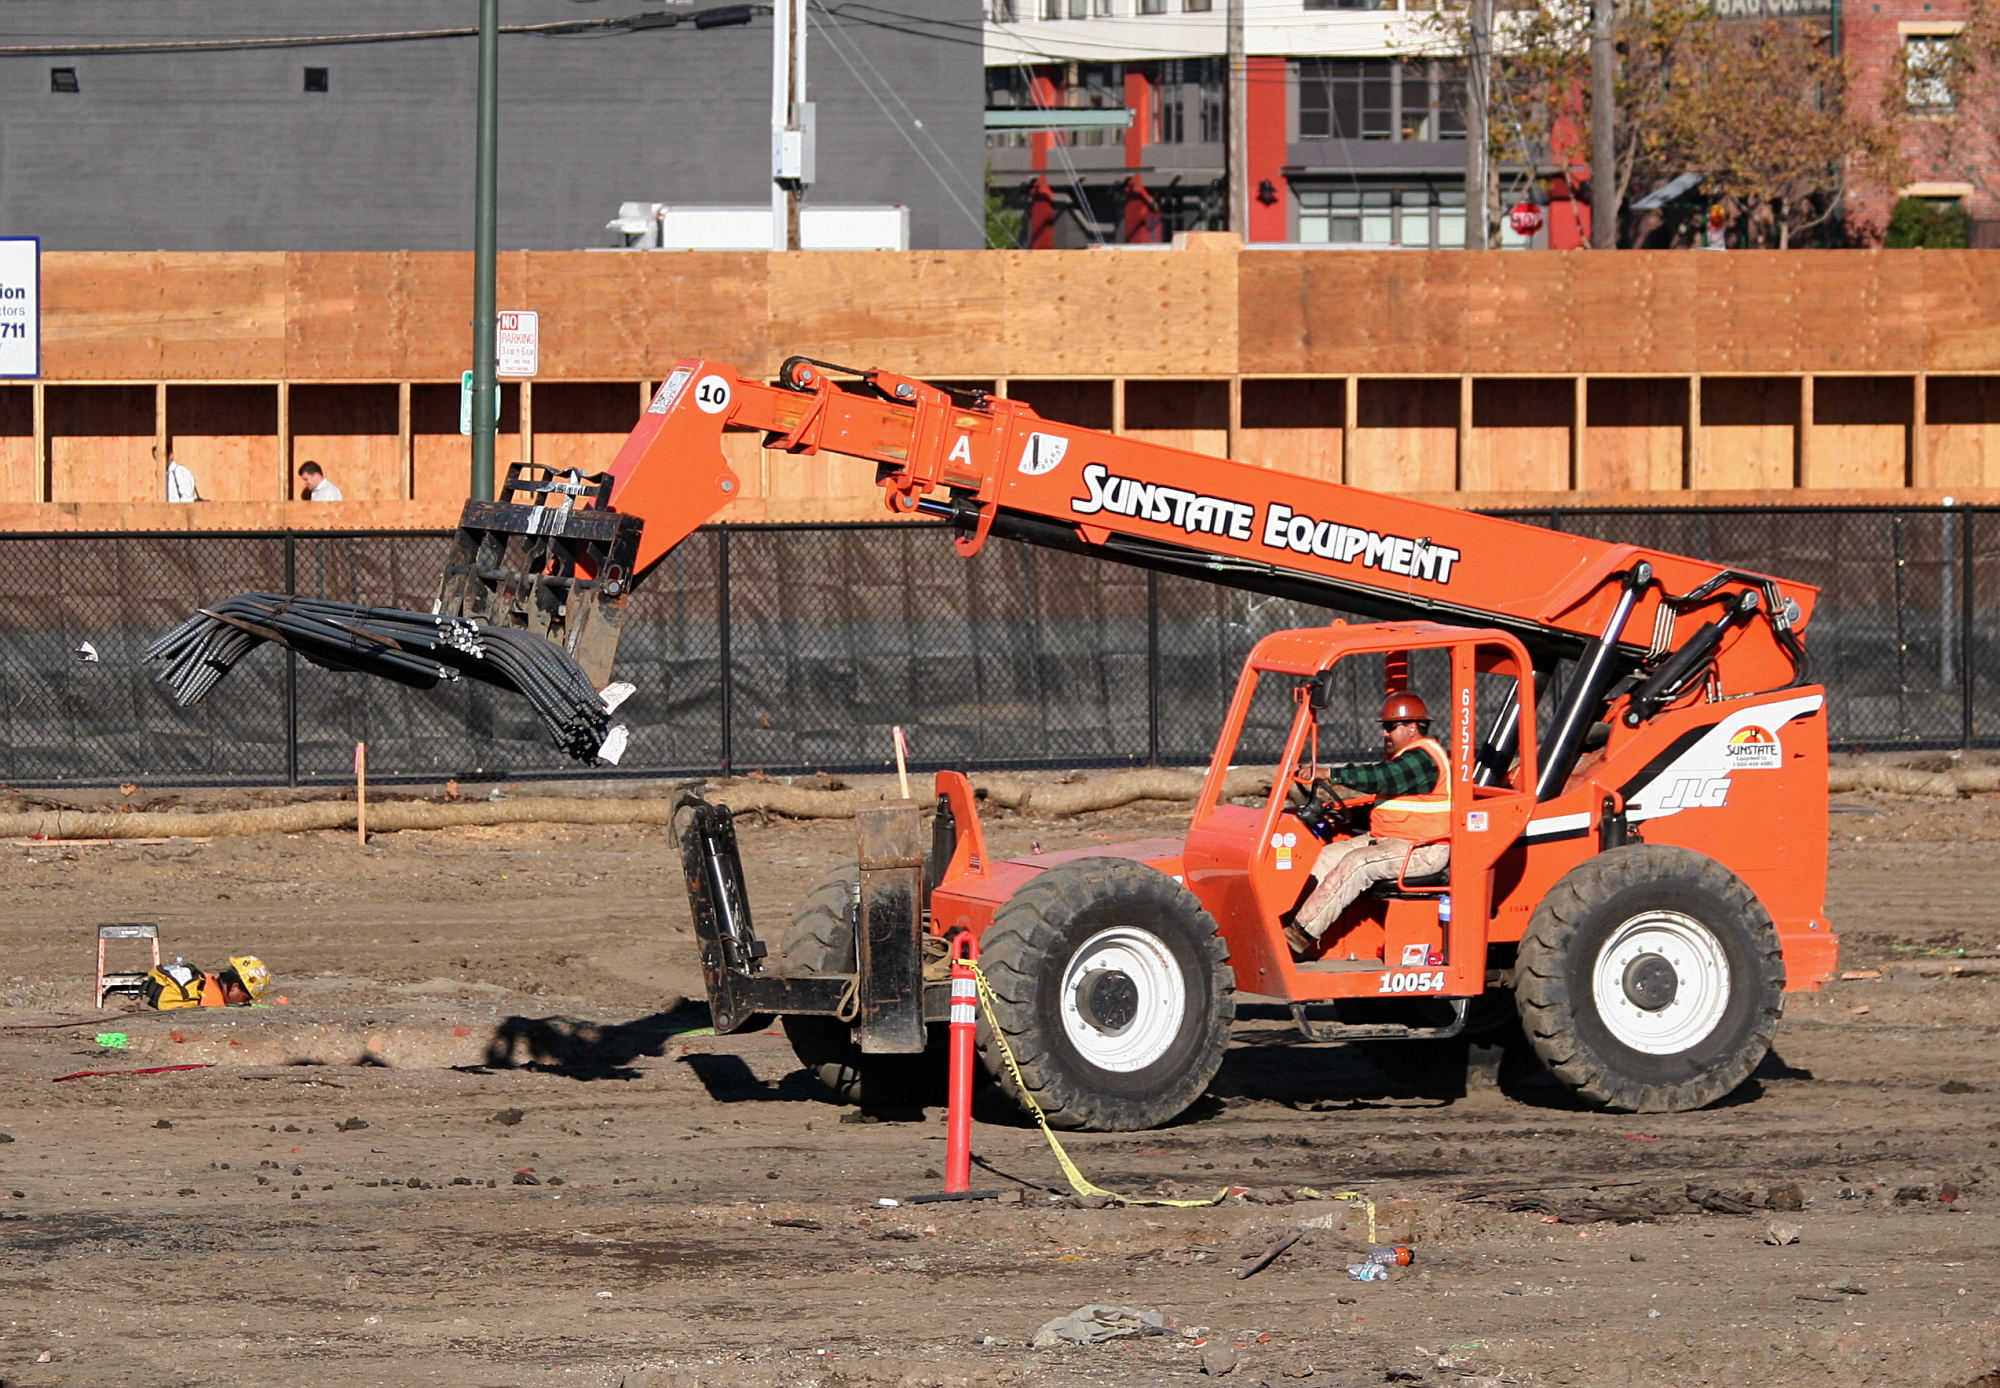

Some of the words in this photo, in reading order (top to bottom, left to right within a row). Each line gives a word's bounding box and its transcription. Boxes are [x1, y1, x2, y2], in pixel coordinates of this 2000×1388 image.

[1512, 212, 1541, 226] STOP
[502, 314, 518, 329] NO
[501, 332, 535, 344] PARKING
[699, 384, 726, 405] 10
[948, 434, 972, 465] A
[1071, 462, 1255, 541] SUNSTATE
[1262, 501, 1461, 585] EQUIPMENT
[1461, 688, 1470, 782] 63572
[1725, 744, 1778, 757] SUNSTATE
[1659, 778, 1732, 809] JLG
[1378, 971, 1444, 993] 10054
